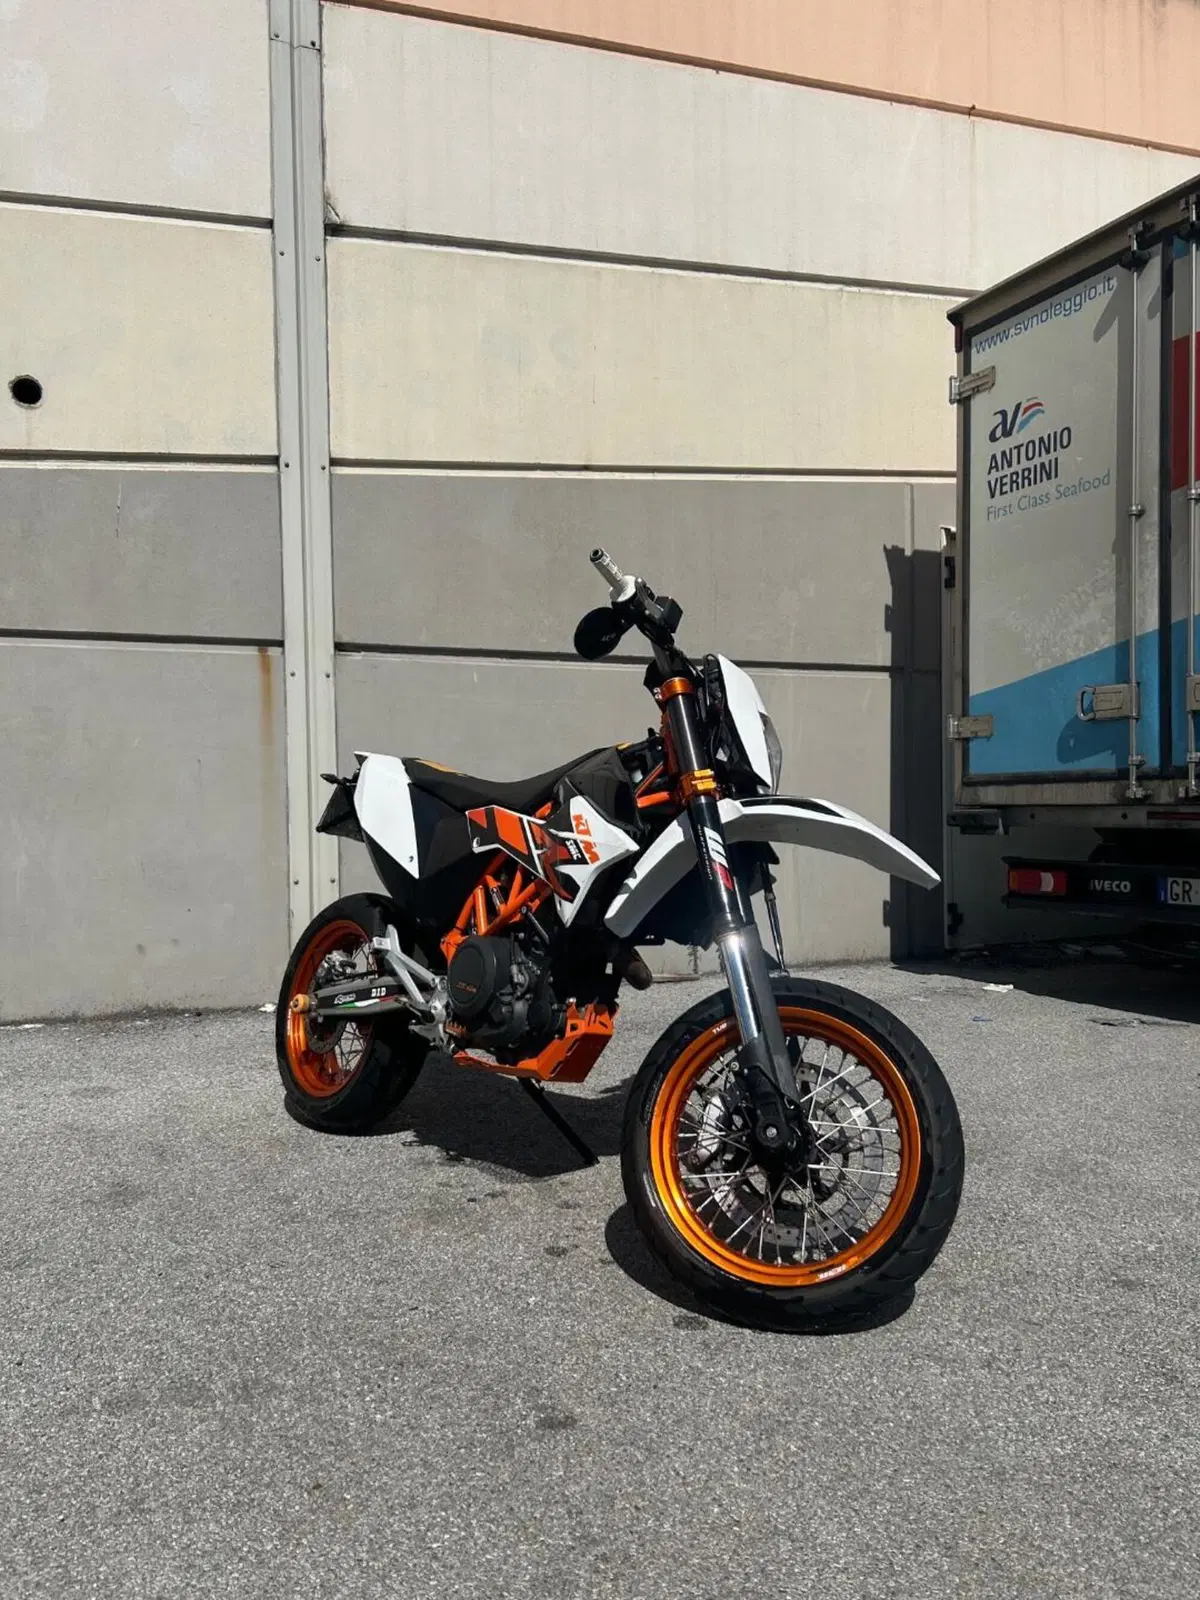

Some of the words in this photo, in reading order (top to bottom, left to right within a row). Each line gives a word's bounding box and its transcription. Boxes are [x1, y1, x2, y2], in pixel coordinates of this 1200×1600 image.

[975, 276, 1116, 354] www.svnoleggio.it
[987, 426, 1072, 476] ANTONIO
[986, 503, 1013, 521] First
[1017, 492, 1051, 511] Class
[1055, 468, 1111, 500] Seafood
[987, 457, 1059, 499] VERRINI
[572, 814, 600, 865] KTM
[1089, 879, 1131, 893] IVECO
[1169, 879, 1192, 903] GR
